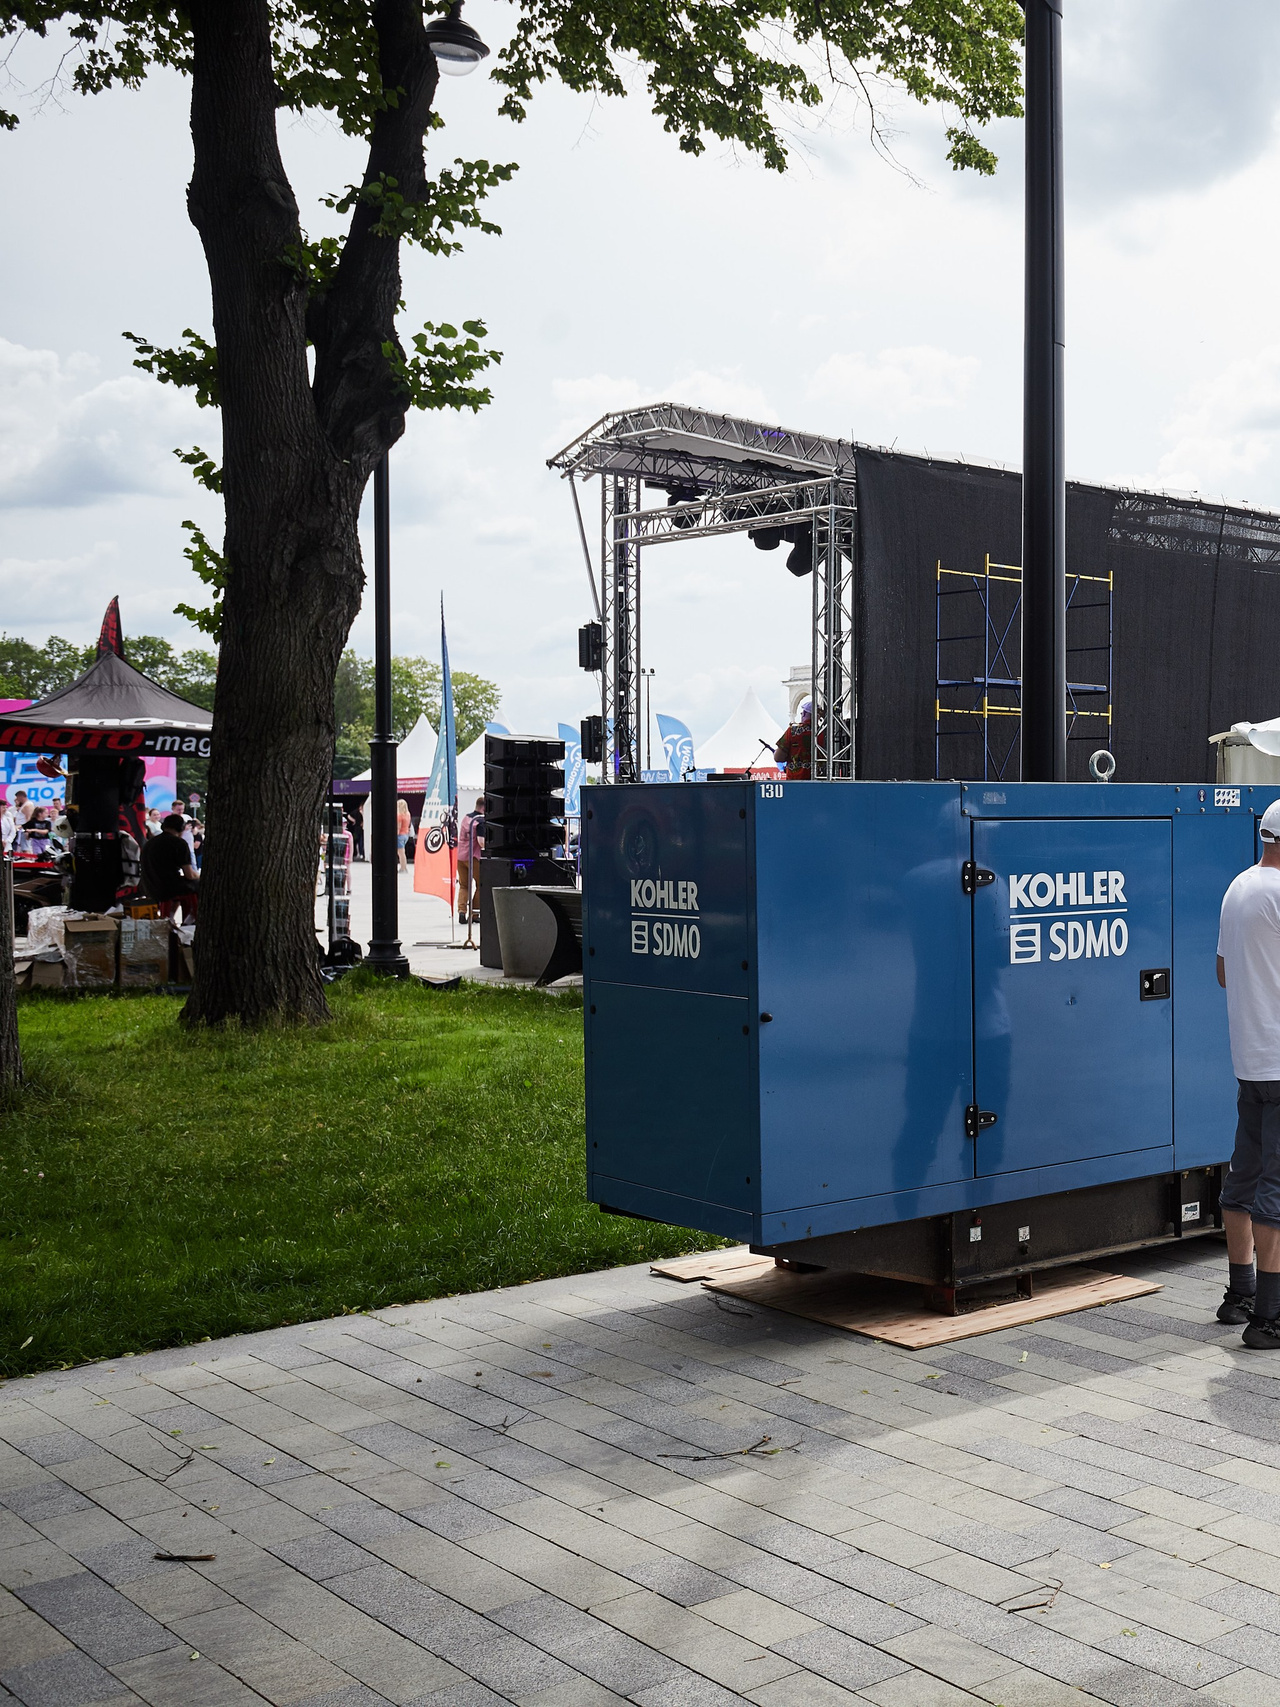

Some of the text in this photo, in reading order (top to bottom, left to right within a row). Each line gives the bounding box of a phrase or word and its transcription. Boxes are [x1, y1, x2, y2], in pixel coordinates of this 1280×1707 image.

[760, 784, 784, 799] 130
[631, 879, 700, 911] KOHLER
[1009, 870, 1128, 909] KOHLER
[652, 922, 701, 959] SDMO
[1048, 917, 1129, 962] SDMO
